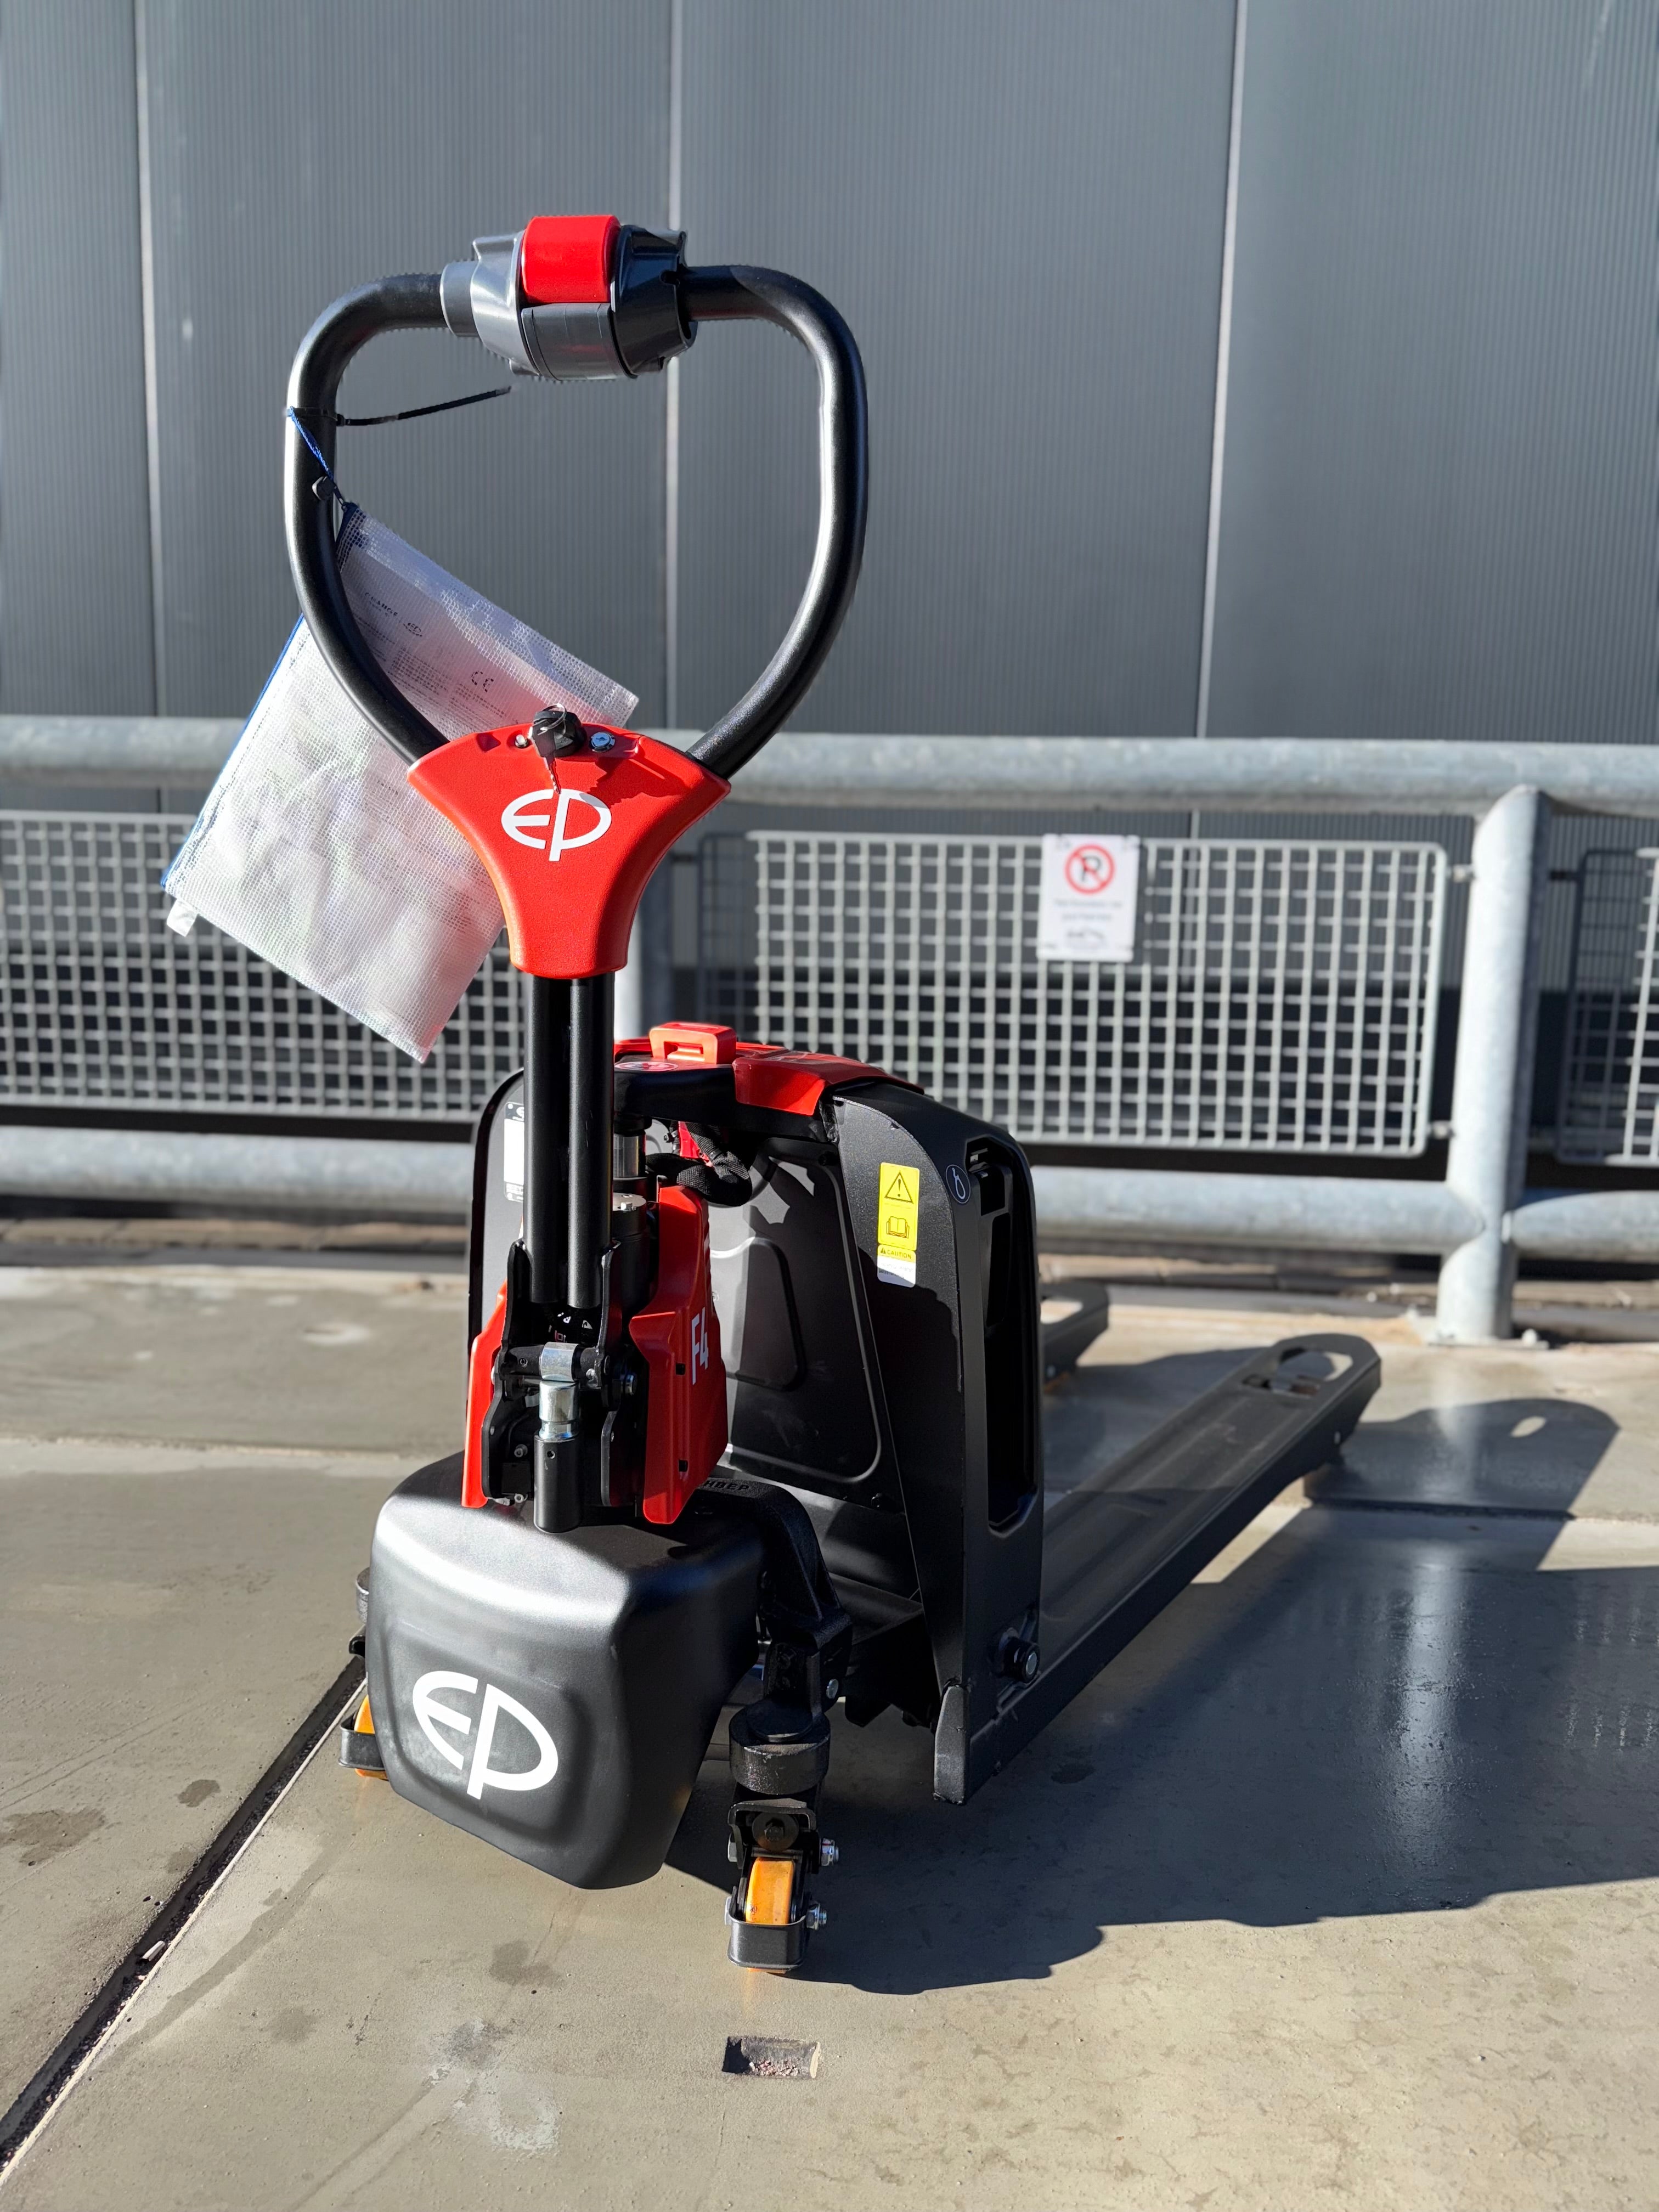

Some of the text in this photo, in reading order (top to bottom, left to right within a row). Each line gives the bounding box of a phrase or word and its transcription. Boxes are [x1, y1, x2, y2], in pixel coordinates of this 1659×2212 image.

[501, 788, 612, 861] EP
[887, 1250, 911, 1260] CAUTION
[691, 1306, 709, 1385] F4
[413, 1671, 558, 1800] EP
